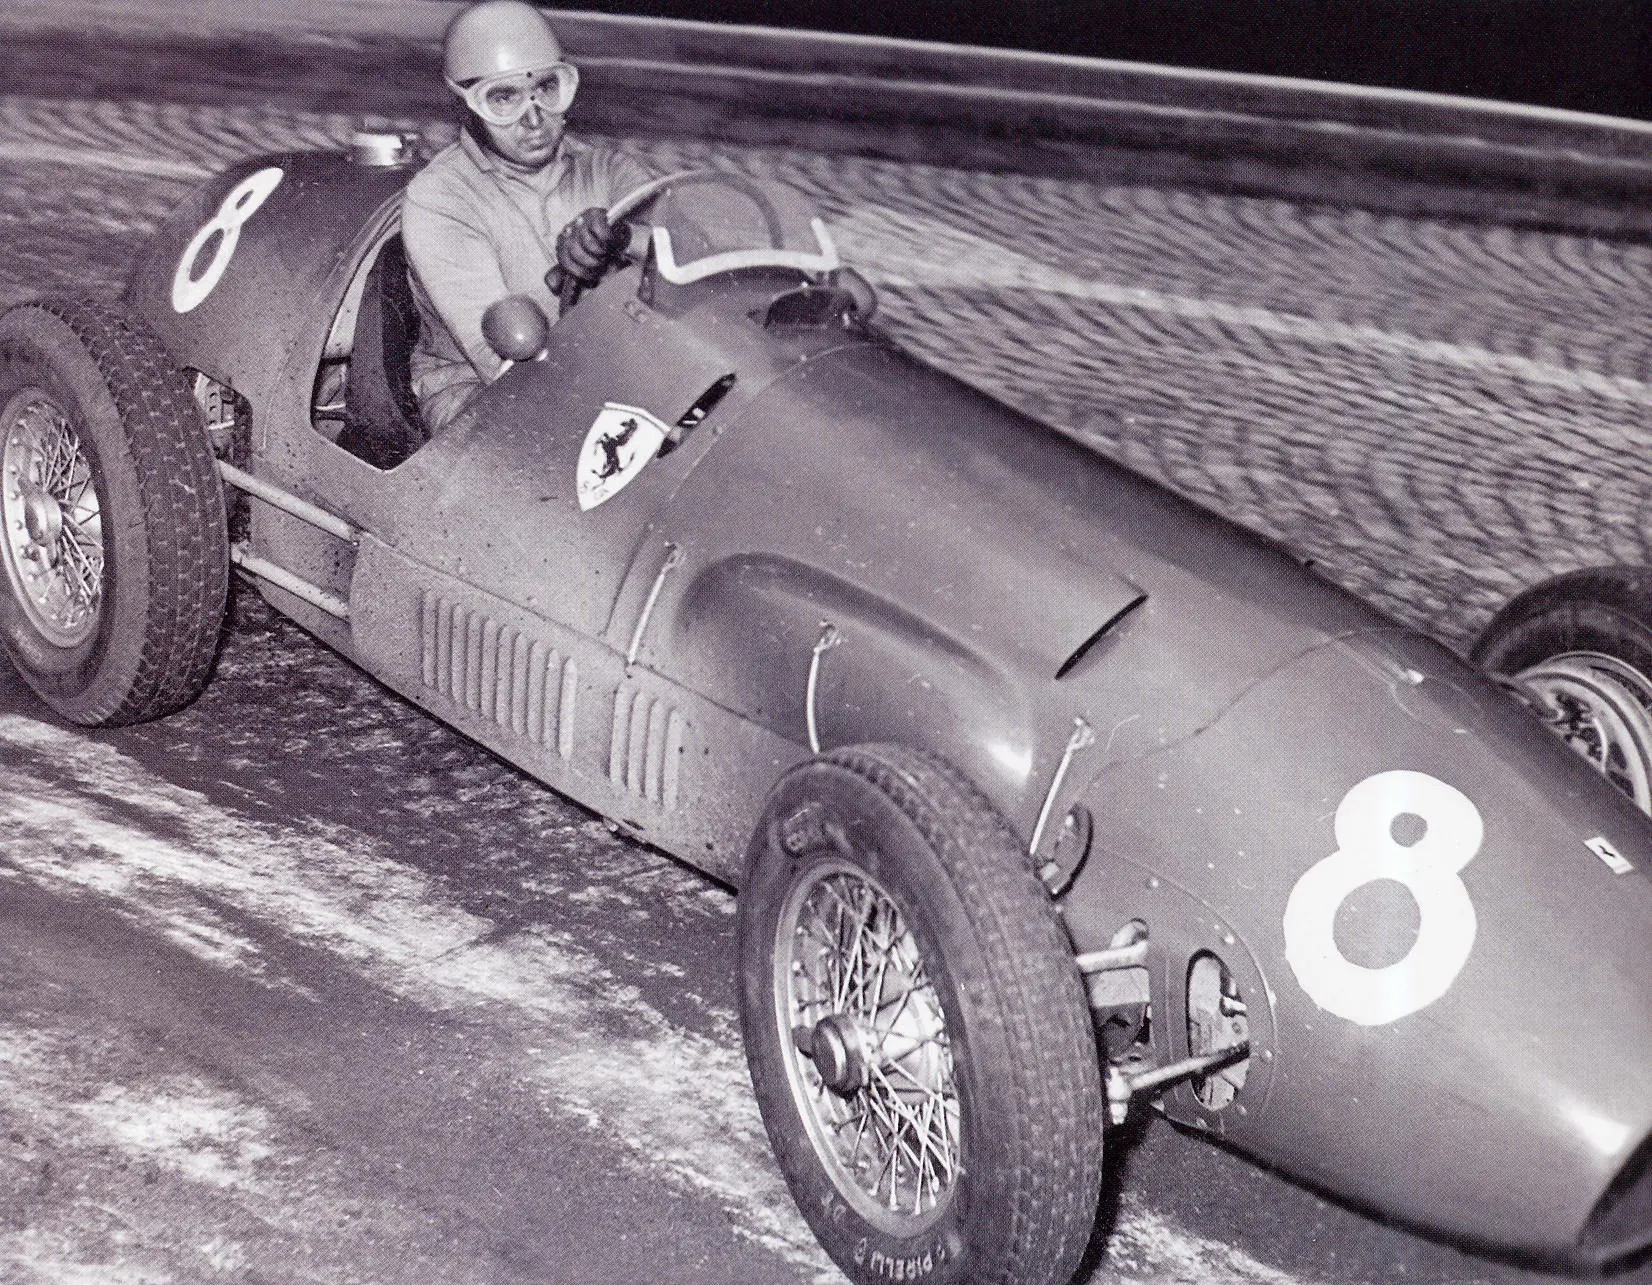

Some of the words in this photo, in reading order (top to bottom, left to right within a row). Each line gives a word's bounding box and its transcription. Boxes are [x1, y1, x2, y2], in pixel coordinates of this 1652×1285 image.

[172, 166, 284, 313] 8
[1283, 769, 1484, 1026] 8
[870, 1250, 933, 1281] PIRELLI
